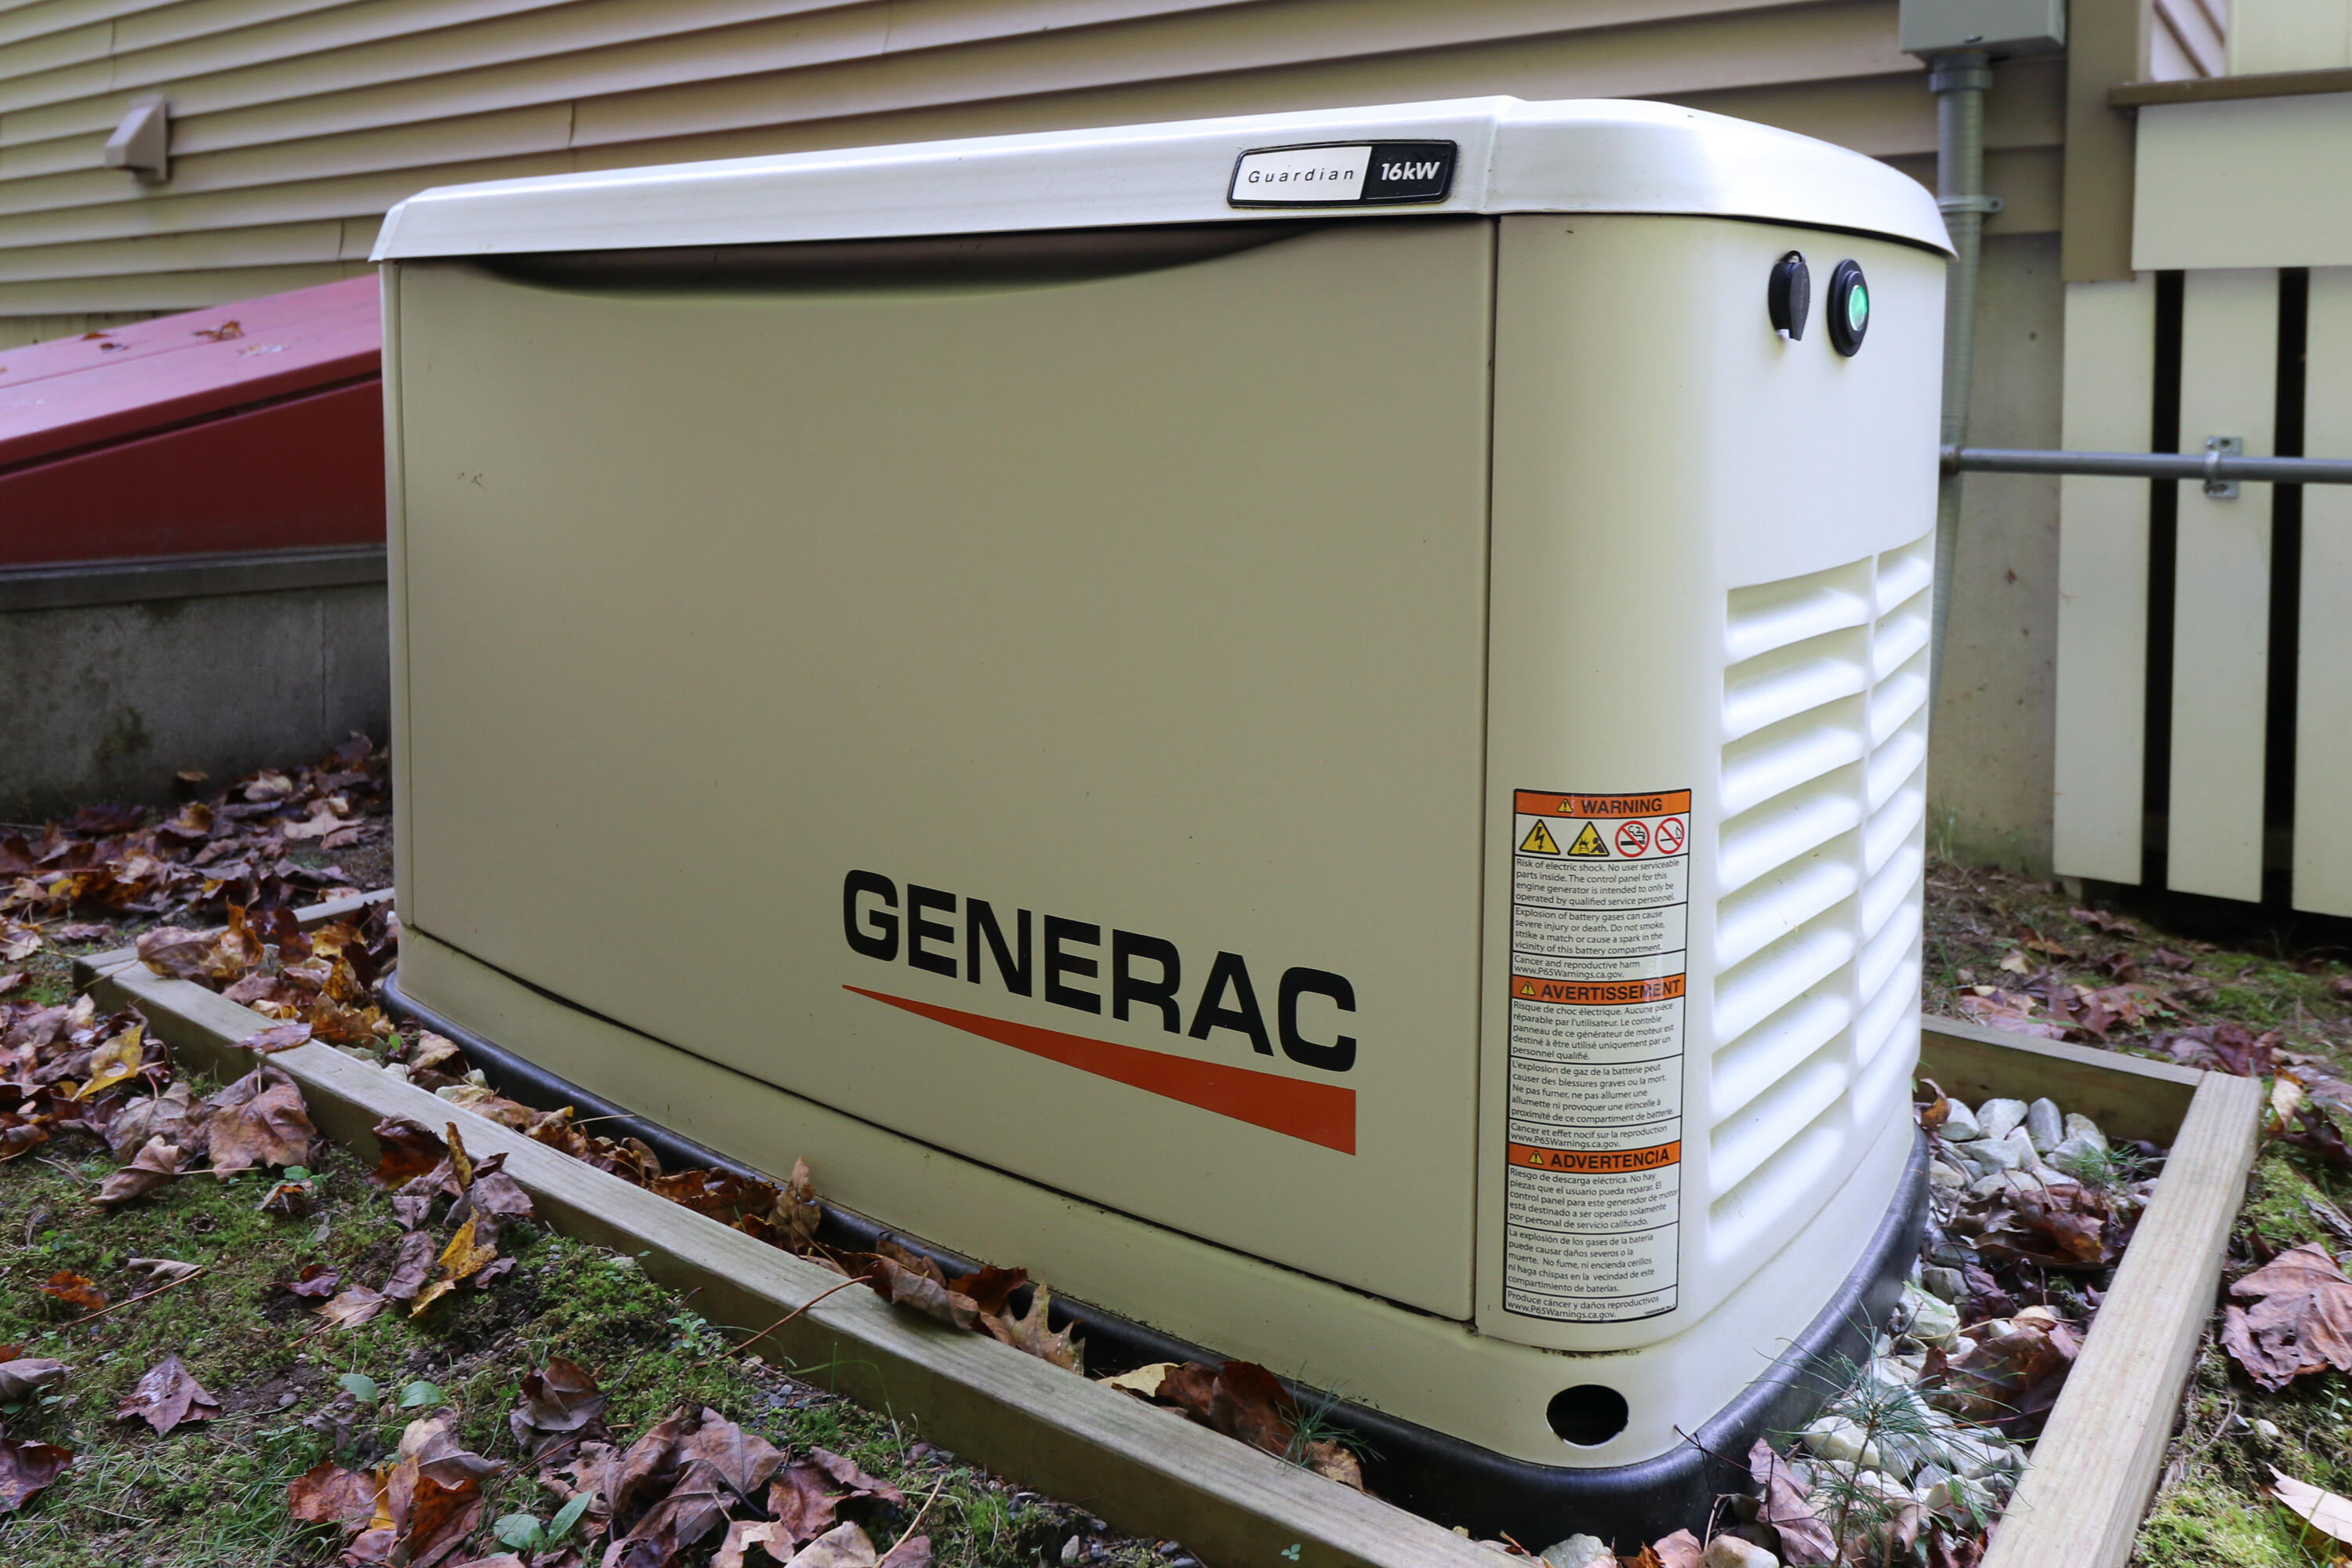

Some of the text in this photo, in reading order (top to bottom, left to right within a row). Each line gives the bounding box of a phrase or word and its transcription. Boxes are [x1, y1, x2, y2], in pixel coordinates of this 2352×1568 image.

[1248, 162, 1441, 183] Guardian 16kW
[1581, 798, 1662, 814] WARNING
[1516, 857, 1534, 868] Risk
[1534, 860, 1544, 869] of
[1545, 861, 1577, 871] electric
[1579, 862, 1606, 872] shock.
[1608, 862, 1620, 872] No
[1516, 871, 1640, 885] parts The control panel
[1515, 881, 1636, 895] engine generator is intended
[1515, 893, 1636, 907] operated by qualified service
[1515, 906, 1556, 919] Explosion
[1558, 911, 1568, 920] of
[1569, 911, 1600, 924] battery
[1602, 914, 1624, 924] gases
[1515, 920, 1542, 929] severe
[1544, 920, 1570, 934] injury
[1582, 923, 1609, 932] death.
[1610, 923, 1623, 932] Do
[1624, 923, 1638, 931] not
[1515, 929, 1537, 939] strike
[1546, 934, 1573, 942] match
[1619, 933, 1640, 945] spark
[1515, 939, 1606, 957] vicinity of this battery
[843, 869, 1356, 1072] GENERAC
[1514, 953, 1640, 971] Cancer and reproductive harm
[1514, 966, 1624, 982] www.P65Warnings.ca.gov.
[1541, 980, 1680, 1000] AVERTISSEMENT
[1513, 1000, 1541, 1014] Risque
[1543, 1004, 1555, 1014] de
[1556, 1006, 1577, 1015] choc
[1624, 1006, 1653, 1015] Aucune
[1513, 1011, 1630, 1029] réparable par Le
[1513, 1025, 1550, 1036] panneau
[1552, 1027, 1563, 1036] de
[1577, 1029, 1623, 1040] générateur
[1624, 1028, 1635, 1037] de
[1512, 1033, 1647, 1051] destiné être utilisé uniquement
[1512, 1046, 1555, 1058] personnel
[1560, 1065, 1643, 1078] de gaz de la batterie
[1512, 1073, 1540, 1083] causer
[1541, 1075, 1556, 1086] des
[1559, 1077, 1598, 1087] blessures
[1599, 1080, 1626, 1090] graves
[1512, 1083, 1524, 1093] Ne
[1526, 1087, 1541, 1096] pas
[1584, 1093, 1599, 1102] pas
[1601, 1090, 1632, 1099] allumer
[1512, 1094, 1551, 1109] allumette
[1552, 1100, 1560, 1109] ni
[1563, 1103, 1606, 1113] provoquer
[1512, 1108, 1551, 1120] proximité
[1552, 1112, 1563, 1122] de
[1576, 1113, 1634, 1126] compartiment
[1635, 1111, 1645, 1121] de
[1511, 1121, 1540, 1134] Cancer
[1541, 1127, 1550, 1136] et
[1552, 1127, 1571, 1138] effet
[1573, 1130, 1595, 1139] nocif
[1611, 1129, 1618, 1138] la
[1511, 1133, 1620, 1151] www.P65Warnings.ca.gov.
[1550, 1149, 1669, 1169] ADVERTENCIA
[1510, 1167, 1642, 1187] Riesgo de descarga No
[1510, 1178, 1624, 1198] piezas que el usuario pueda
[1509, 1191, 1539, 1203] control
[1541, 1196, 1565, 1206] panel
[1566, 1200, 1585, 1208] para
[1606, 1195, 1647, 1209] generador
[1509, 1202, 1526, 1210] está
[1528, 1203, 1570, 1217] destinado
[1593, 1207, 1628, 1220] operado
[1509, 1213, 1609, 1229] por personal de servicio
[1508, 1226, 1620, 1248] La explosión de los gases de
[1508, 1240, 1534, 1252] puede
[1535, 1246, 1562, 1256] causar
[1563, 1247, 1588, 1258] daños
[1508, 1252, 1626, 1269] muerte. No fume, encienda
[1517, 1263, 1537, 1277] haga
[1538, 1268, 1569, 1281] chispas
[1593, 1270, 1628, 1281] vecindad
[1629, 1269, 1639, 1279] de
[1508, 1275, 1584, 1292] compartimiento de
[1508, 1289, 1541, 1305] Produce
[1581, 1300, 1606, 1309] daños
[1507, 1301, 1616, 1321] www.P65Warnings.ca.gov.
